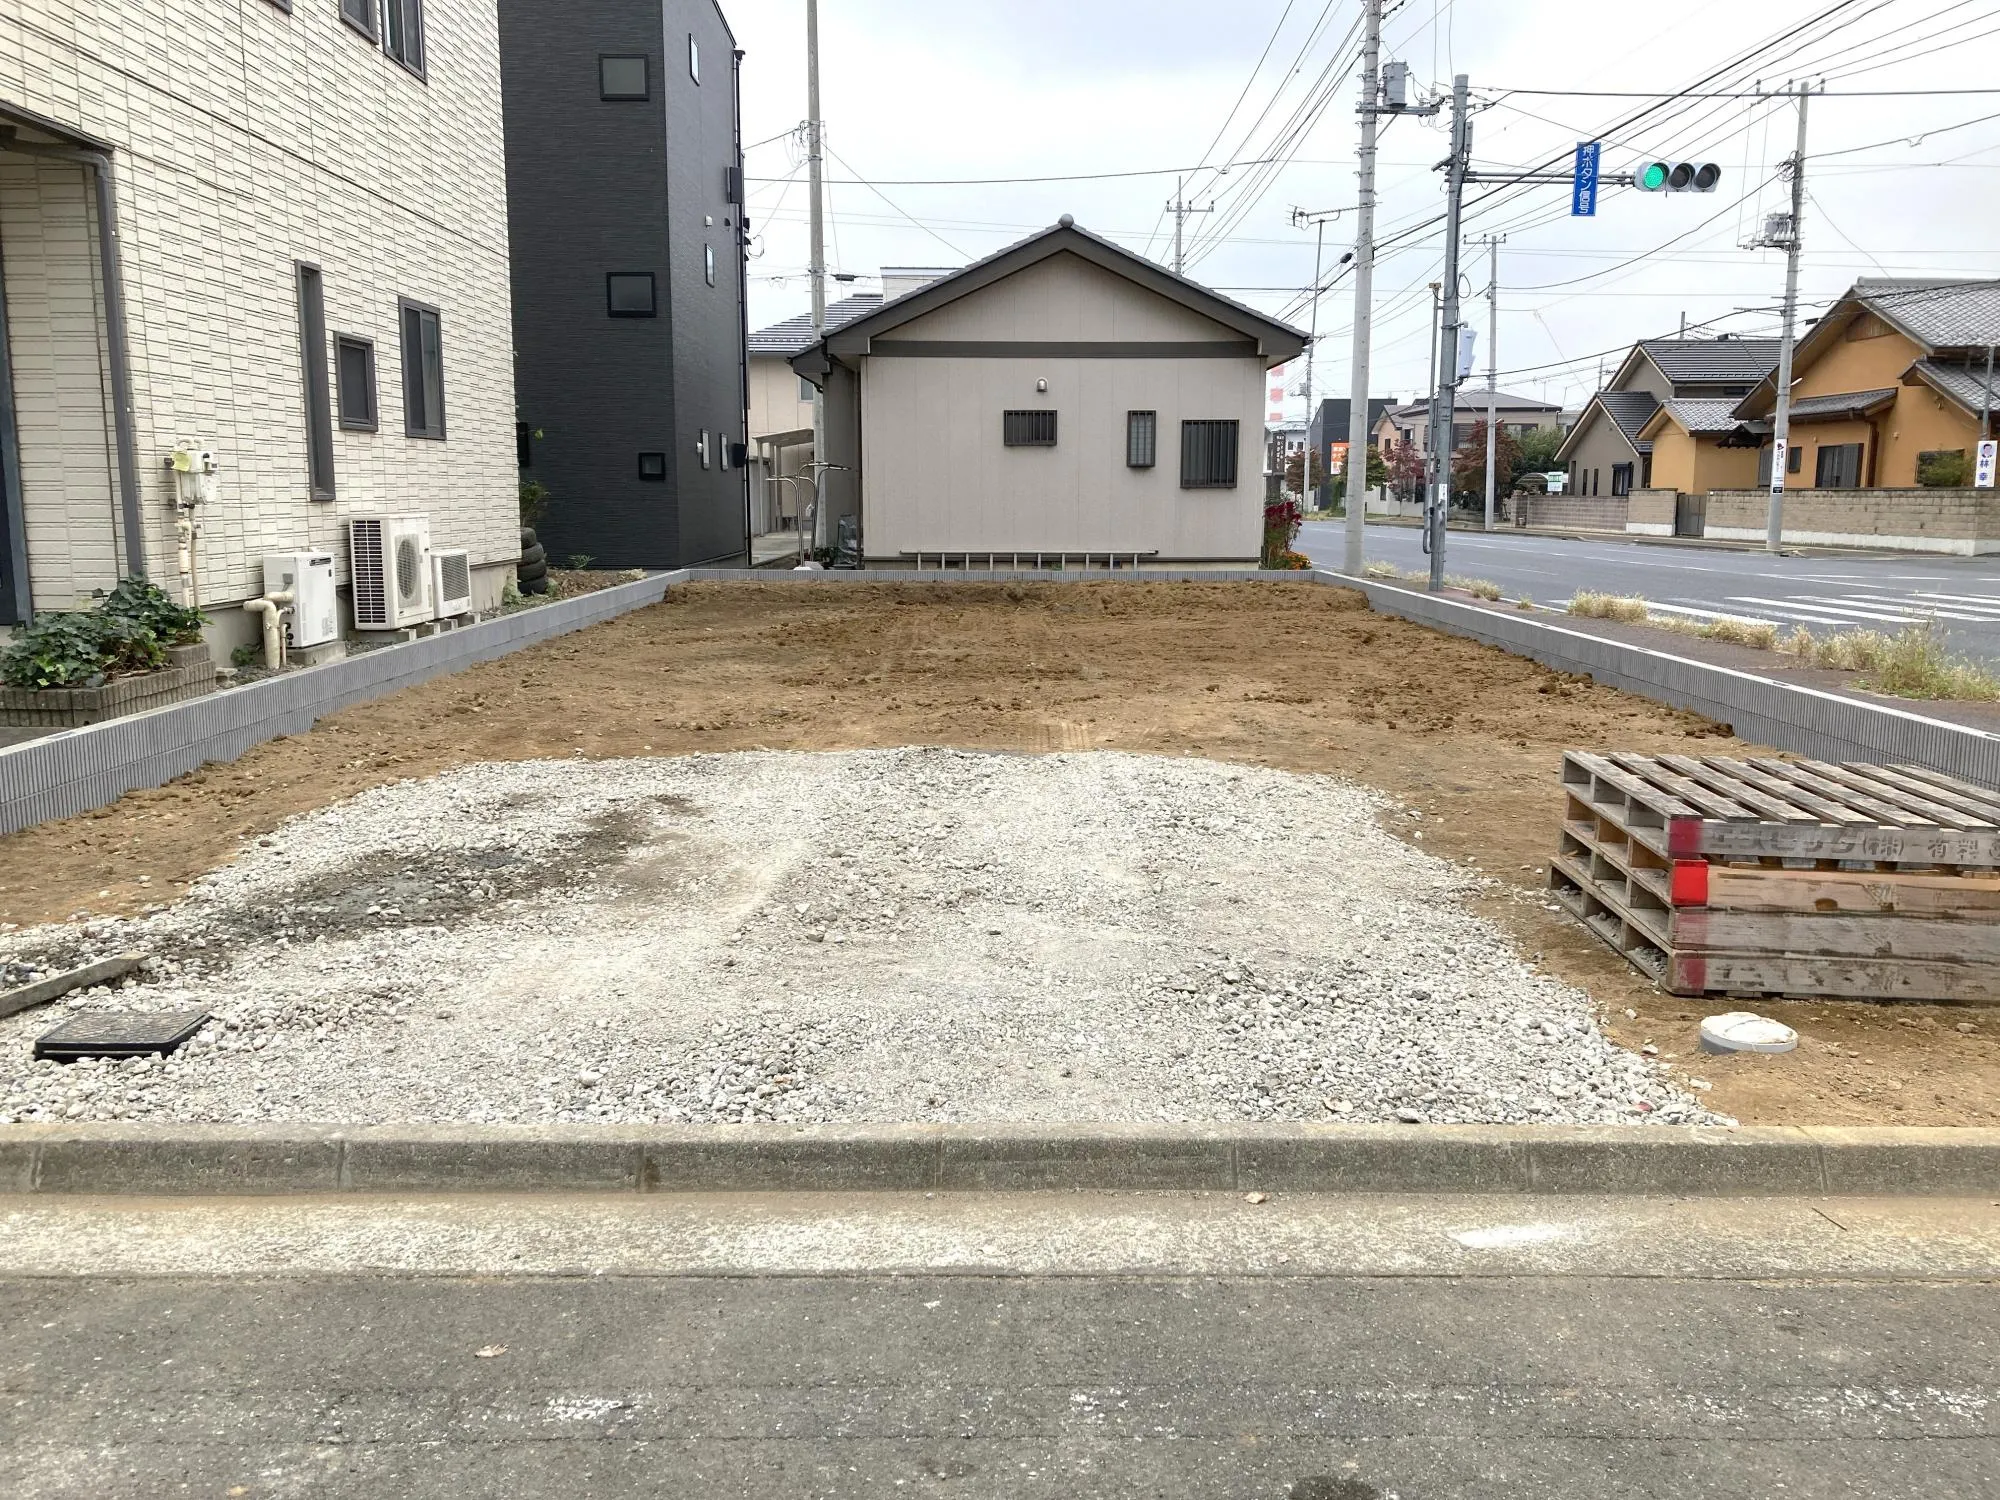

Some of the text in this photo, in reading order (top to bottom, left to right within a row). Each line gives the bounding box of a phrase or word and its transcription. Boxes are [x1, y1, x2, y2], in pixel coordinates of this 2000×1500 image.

[1578, 144, 1595, 214] 押ボタン信号
